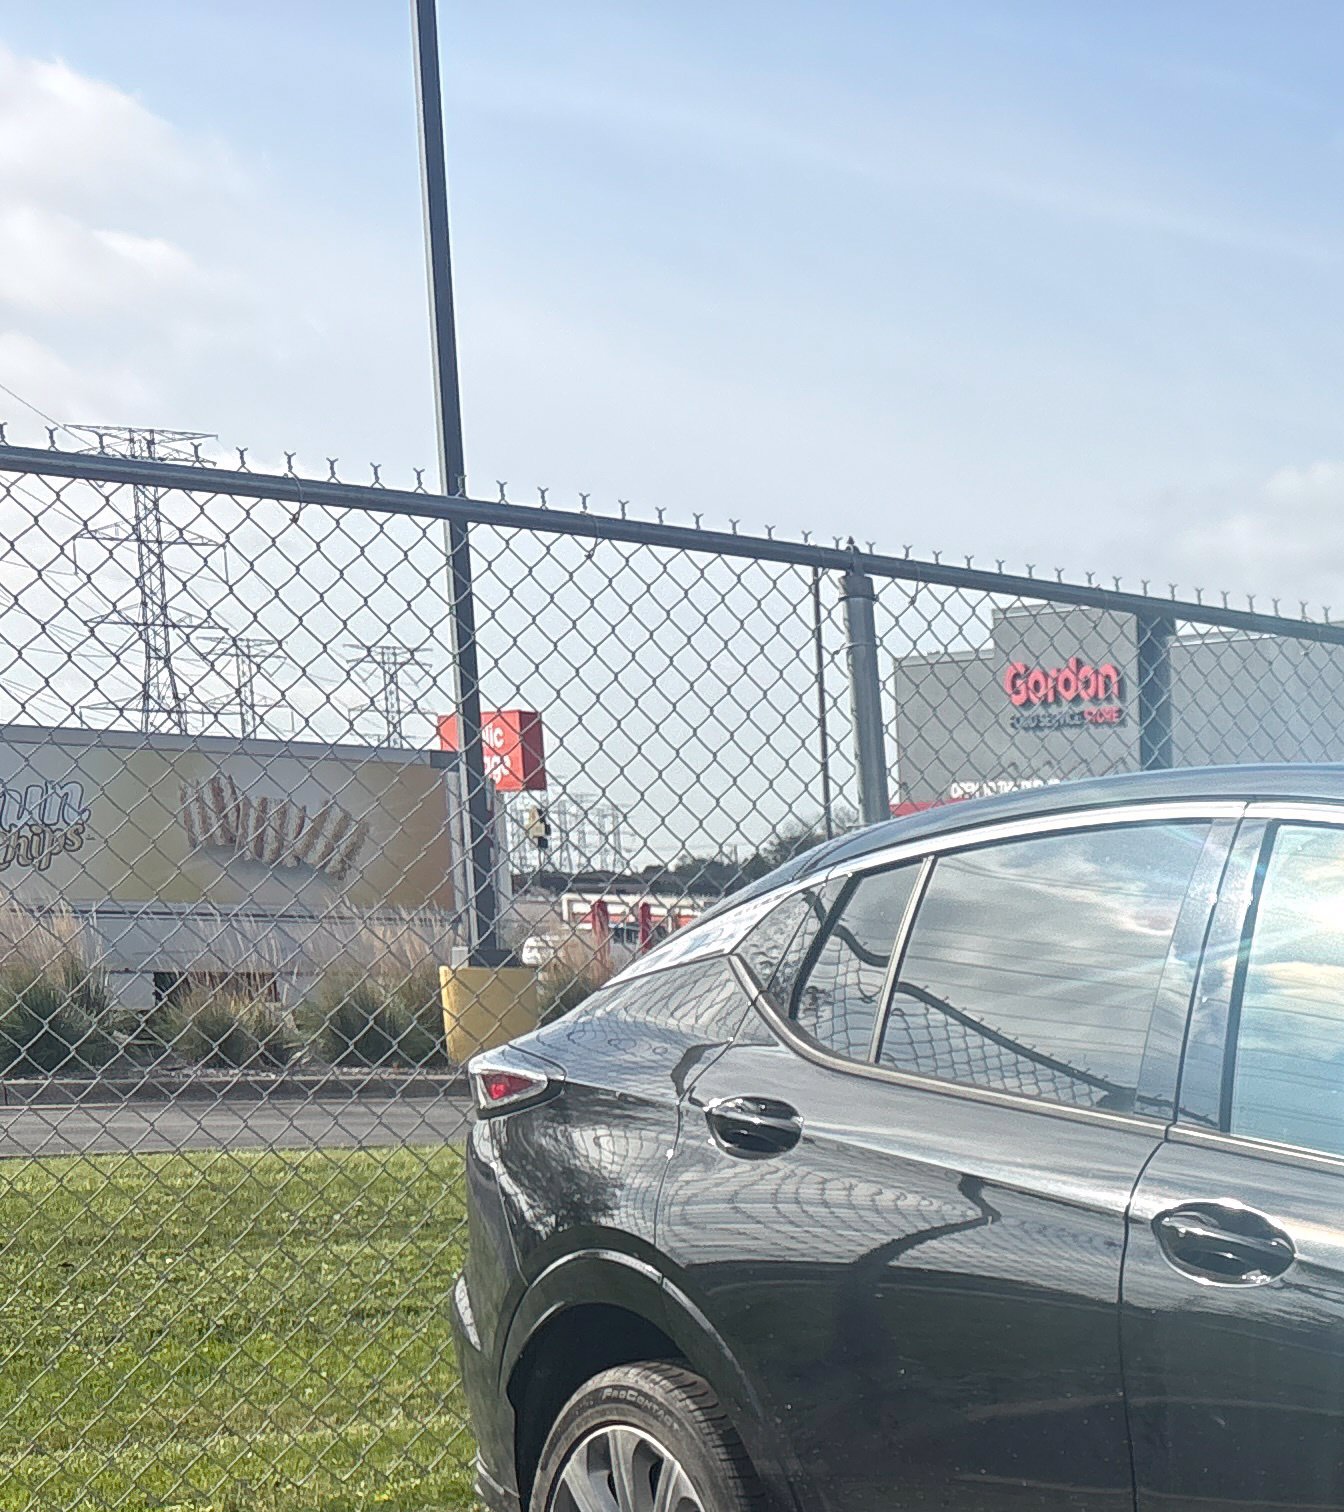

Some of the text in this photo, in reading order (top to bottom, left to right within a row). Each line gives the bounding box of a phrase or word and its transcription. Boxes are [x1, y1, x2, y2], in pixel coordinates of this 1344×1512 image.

[1004, 656, 1119, 706] Gordon
[0, 780, 91, 833] un
[0, 821, 85, 872] hips
